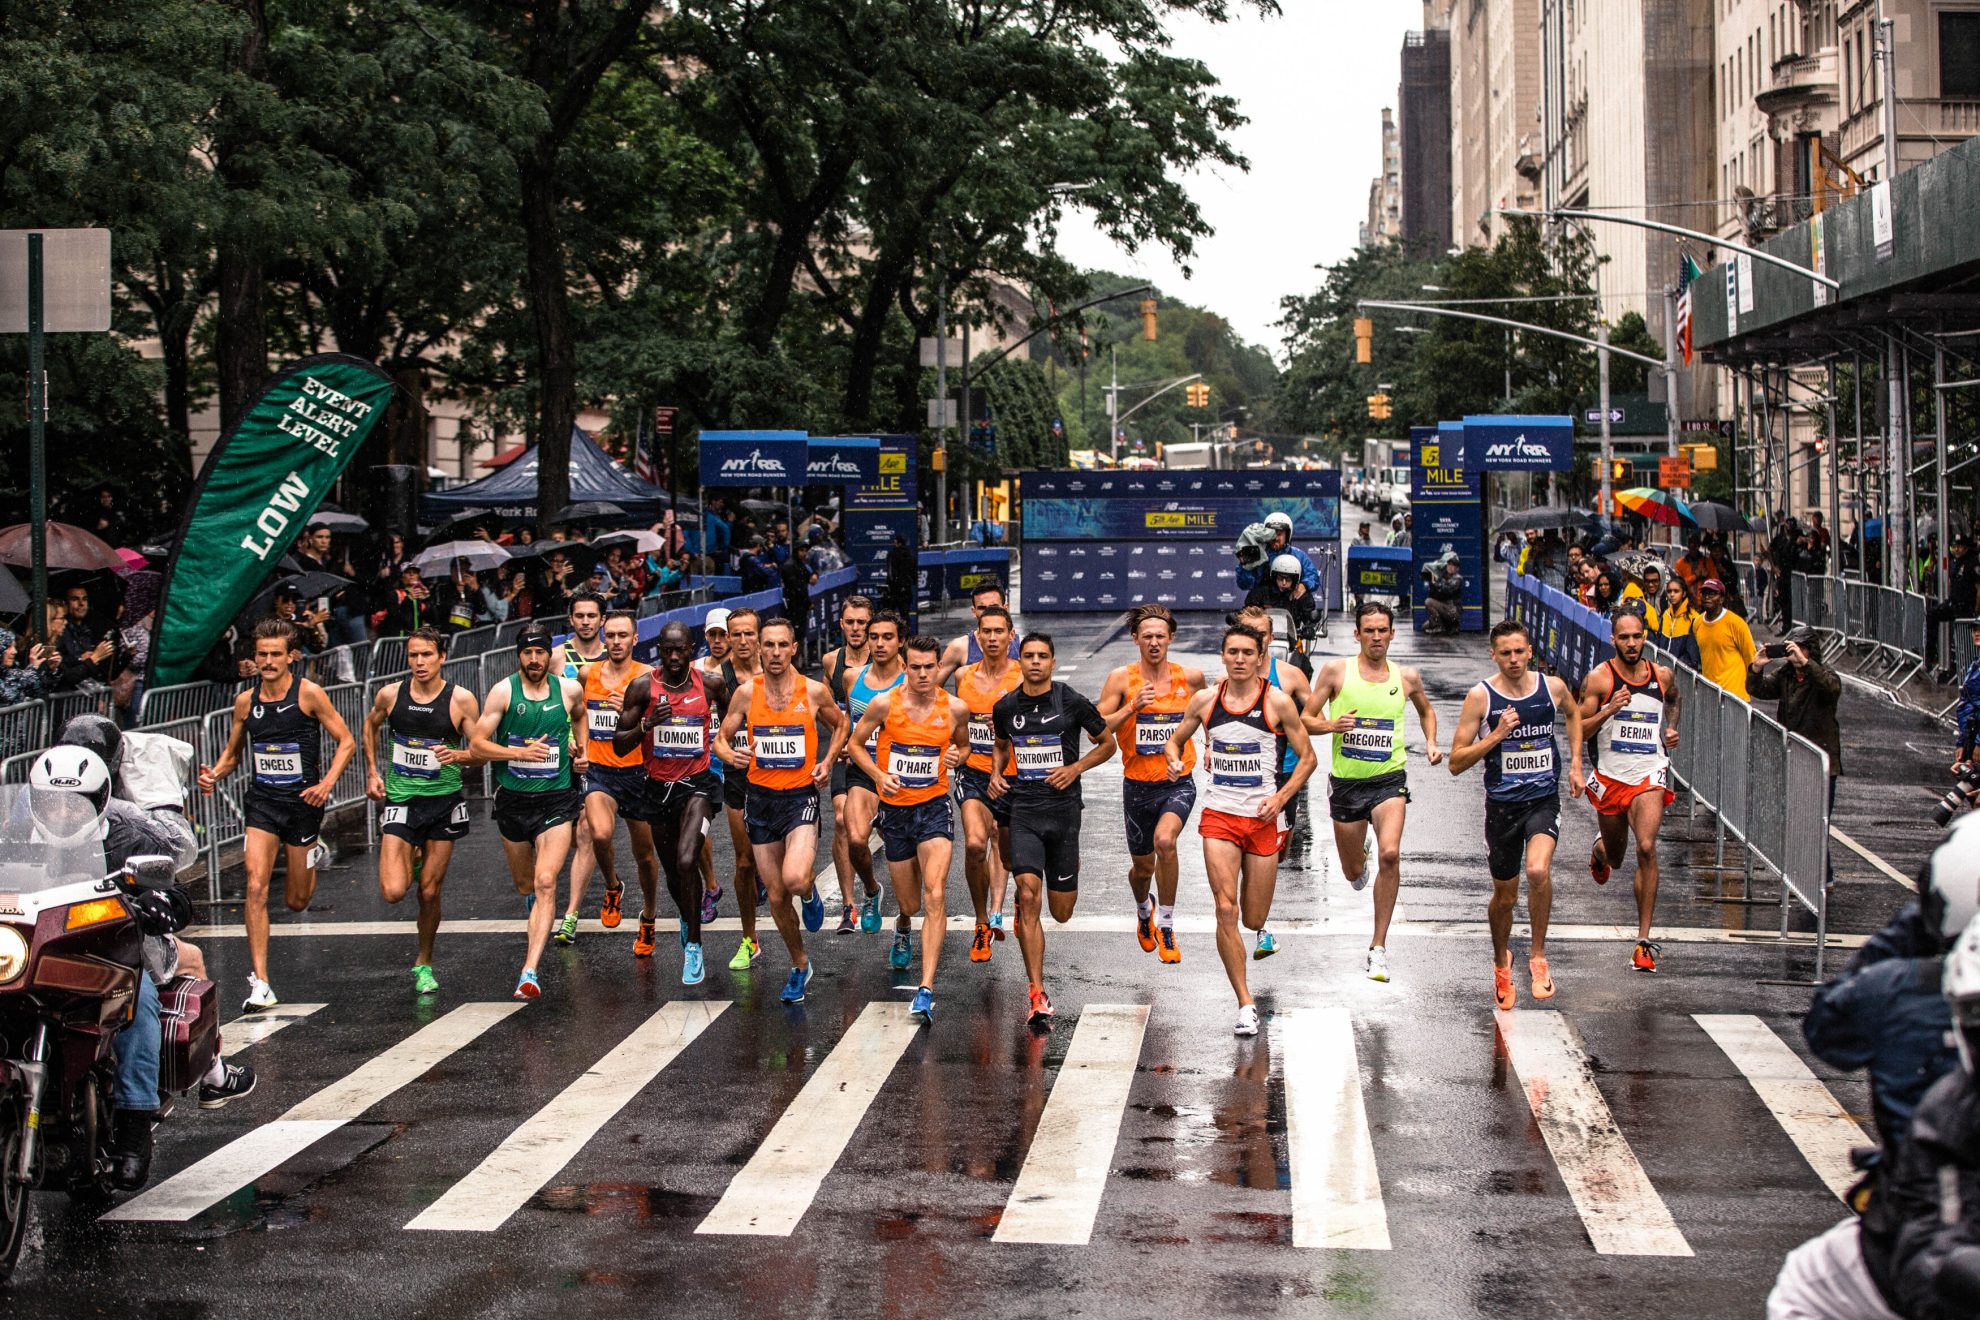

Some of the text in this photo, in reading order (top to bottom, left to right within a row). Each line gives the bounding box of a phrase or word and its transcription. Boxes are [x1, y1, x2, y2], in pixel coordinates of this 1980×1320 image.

[301, 376, 373, 419] EVENT
[289, 396, 359, 437] ALERT
[277, 413, 343, 458] LEVEL
[1427, 469, 1463, 483] MILE
[240, 470, 310, 561] LOW
[1187, 515, 1216, 525] MILE
[408, 705, 434, 714] saucony
[594, 714, 618, 728] AVILA
[658, 730, 700, 744] LOMONG
[1507, 721, 1553, 739] cotland
[1620, 725, 1653, 740] BERIAN
[1342, 732, 1393, 748] GREGOREK
[761, 741, 796, 755] WILLIS
[260, 758, 294, 771] ENGELS
[404, 751, 429, 766] TRUE
[1016, 751, 1063, 764] CENTROWITZ
[1213, 757, 1261, 772] WIGHTMAN
[1506, 753, 1550, 770] GOURLEY
[896, 759, 933, 774] O'HARE
[1588, 777, 1600, 793] 23
[386, 807, 399, 822] 17
